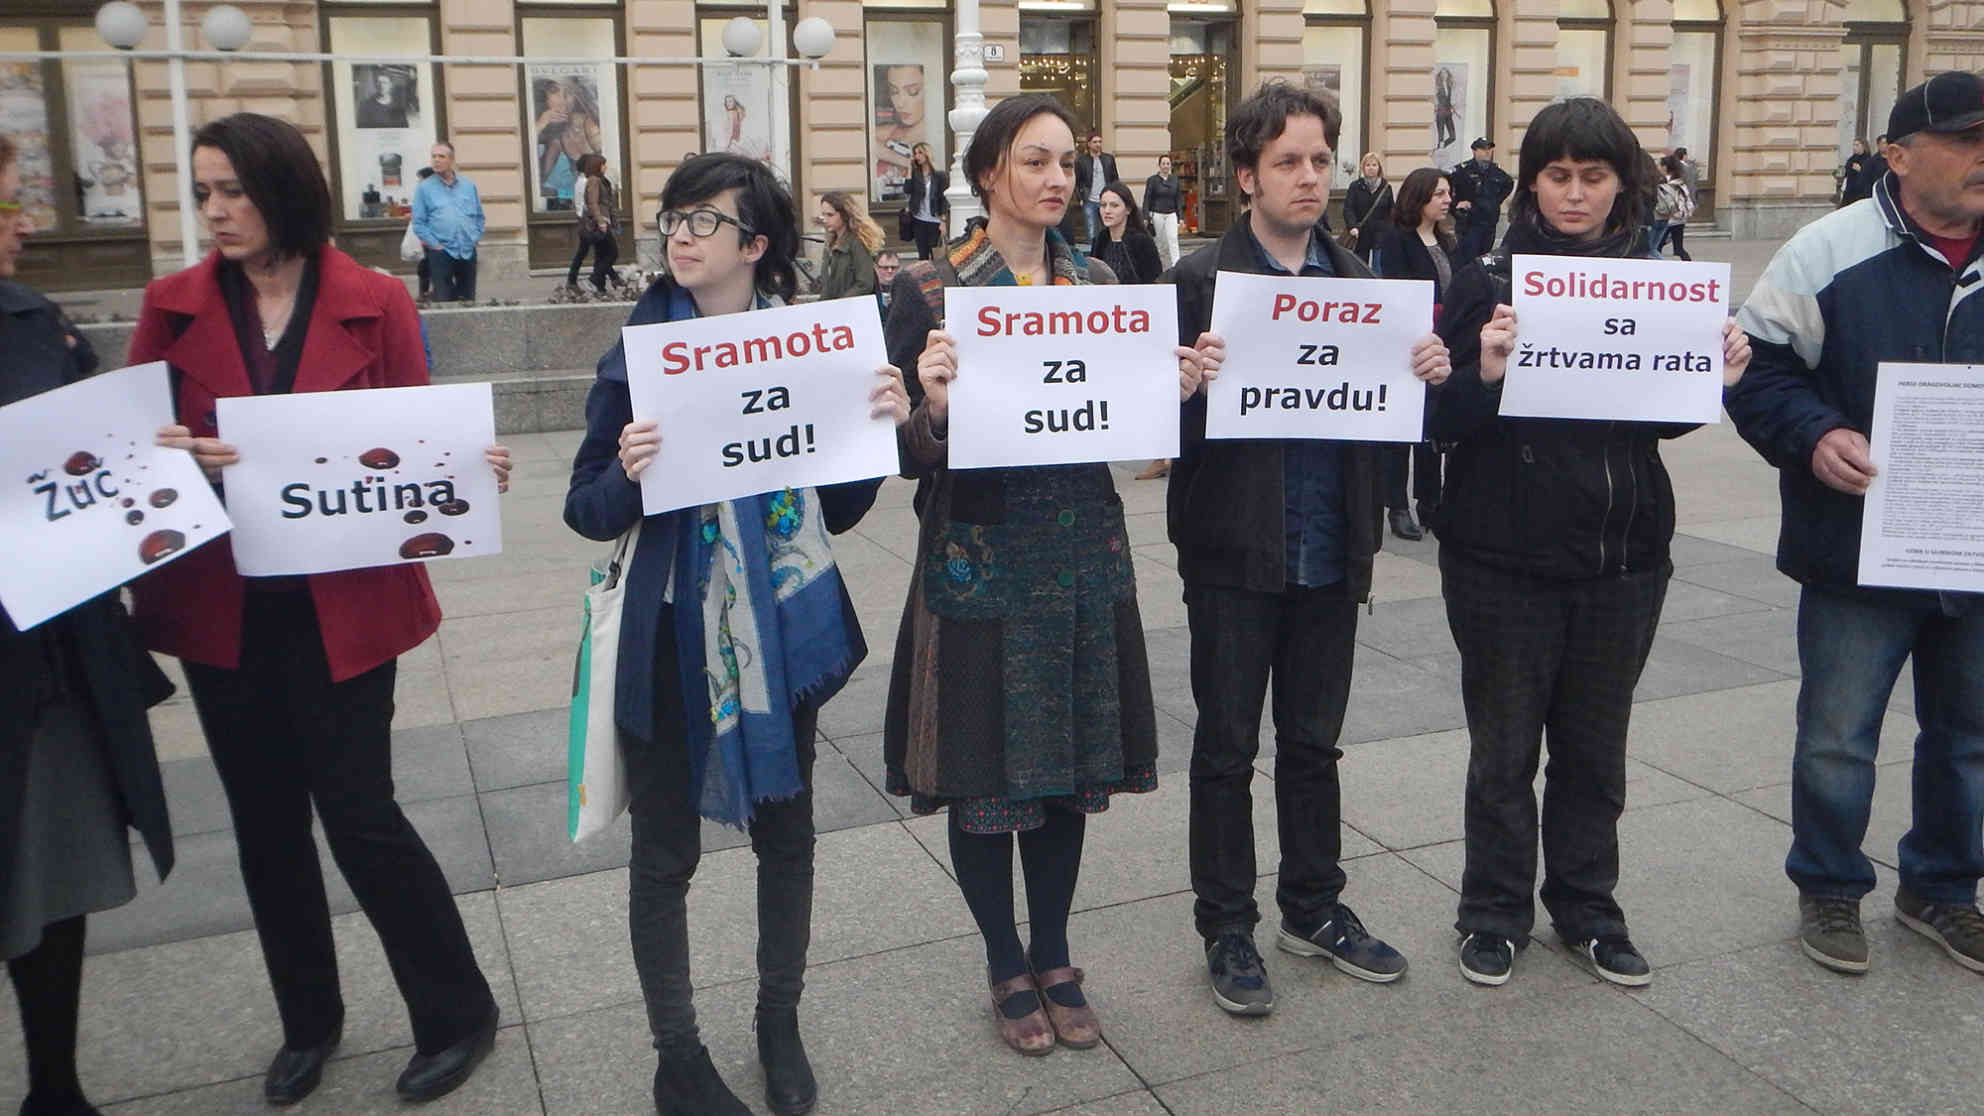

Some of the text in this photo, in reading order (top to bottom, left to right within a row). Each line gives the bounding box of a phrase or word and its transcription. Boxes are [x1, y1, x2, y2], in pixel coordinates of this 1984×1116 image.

[1524, 271, 1721, 303] Solidarnost
[977, 304, 1150, 337] Sramota
[1271, 293, 1383, 324] Poraz
[1603, 318, 1636, 336] sa
[660, 322, 855, 376] Sramota
[1296, 344, 1340, 366] za
[1517, 342, 1712, 373] žrtvama rata
[1043, 359, 1087, 384] za
[741, 385, 791, 415] za
[1240, 382, 1387, 416] pravdu!
[1024, 400, 1109, 434] sud!
[721, 424, 816, 468] sud!
[281, 476, 456, 518] Sutina
